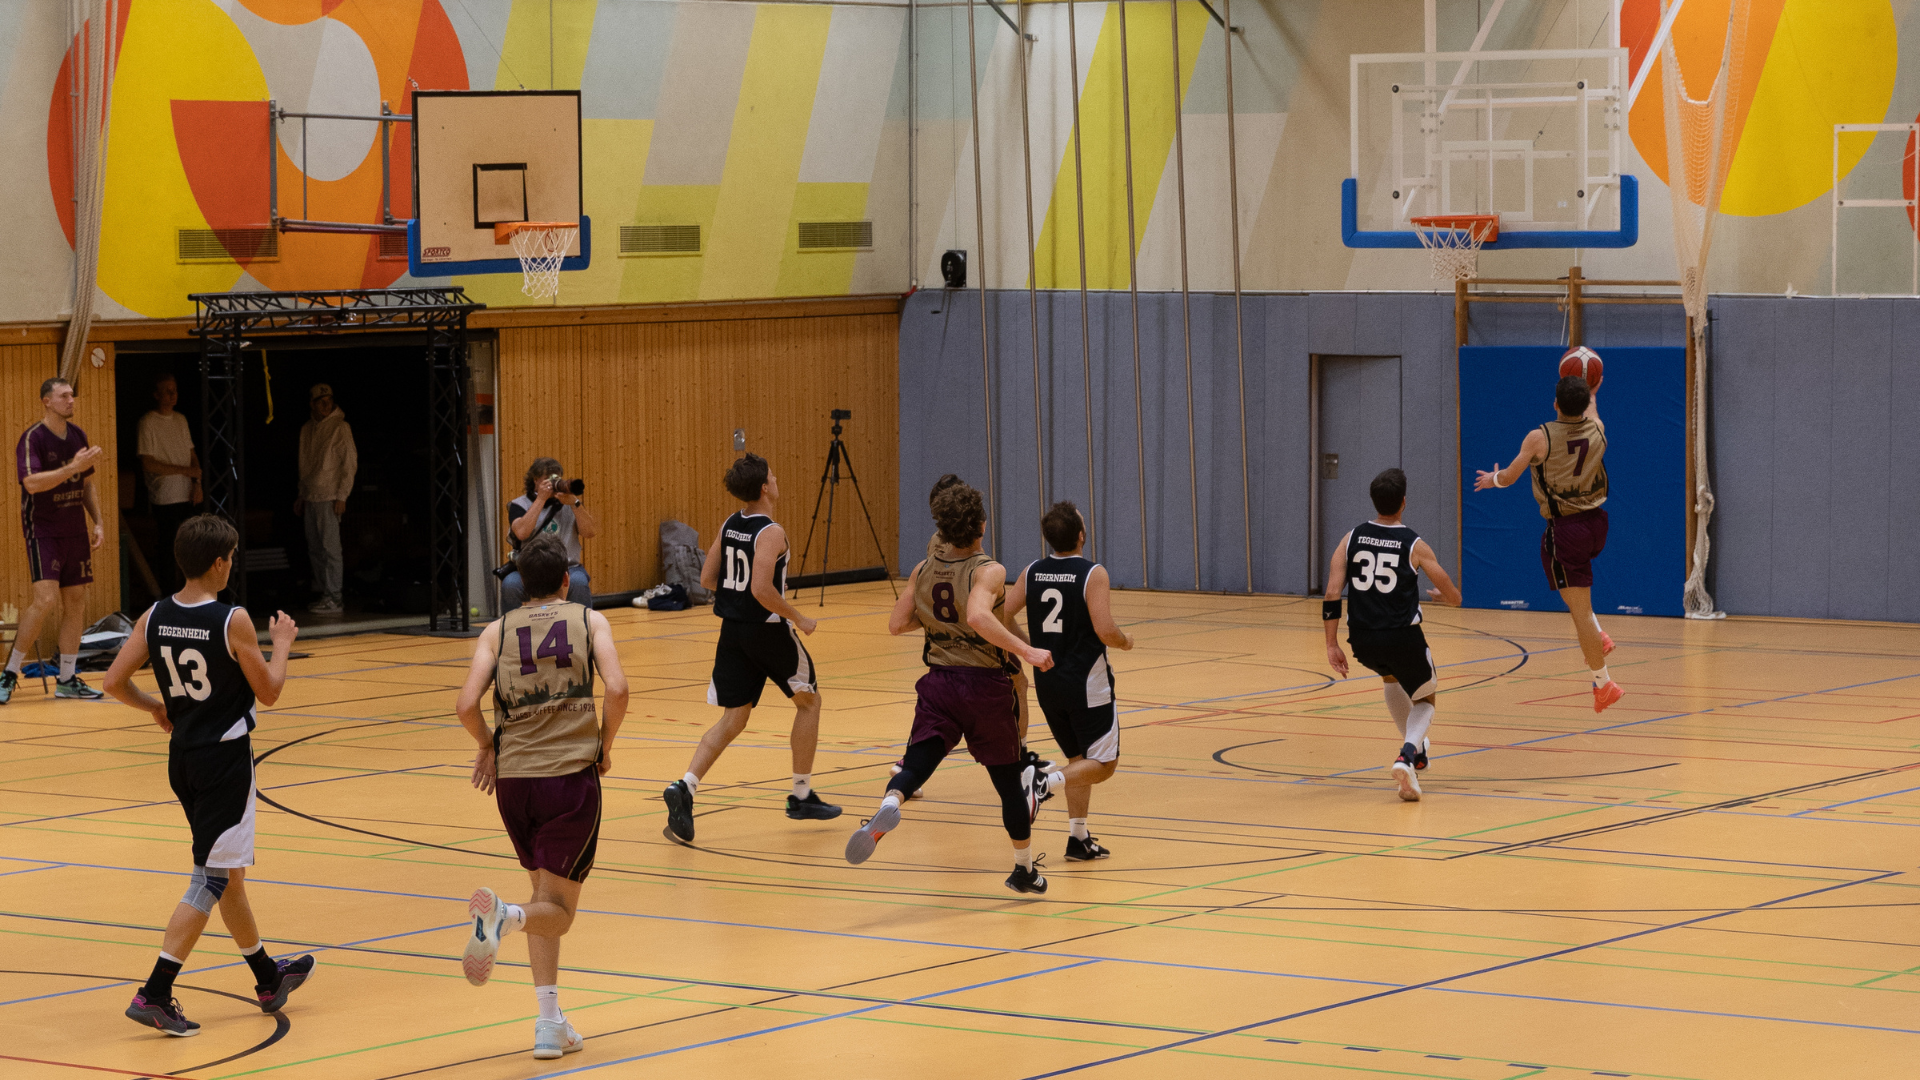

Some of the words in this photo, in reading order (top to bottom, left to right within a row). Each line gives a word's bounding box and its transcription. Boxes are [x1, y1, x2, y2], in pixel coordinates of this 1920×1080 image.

[1566, 438, 1590, 477] 7
[1358, 536, 1402, 549] TEGERNHEIM
[723, 545, 750, 592] 10
[1034, 572, 1077, 583] TEGERNHEIM
[1352, 550, 1400, 594] 35
[932, 582, 959, 624] 8
[1040, 588, 1063, 633] 2
[158, 625, 211, 641] TEGERNHEIM
[516, 619, 574, 676] 14
[160, 645, 213, 702] 13
[580, 702, 596, 712] 1928
